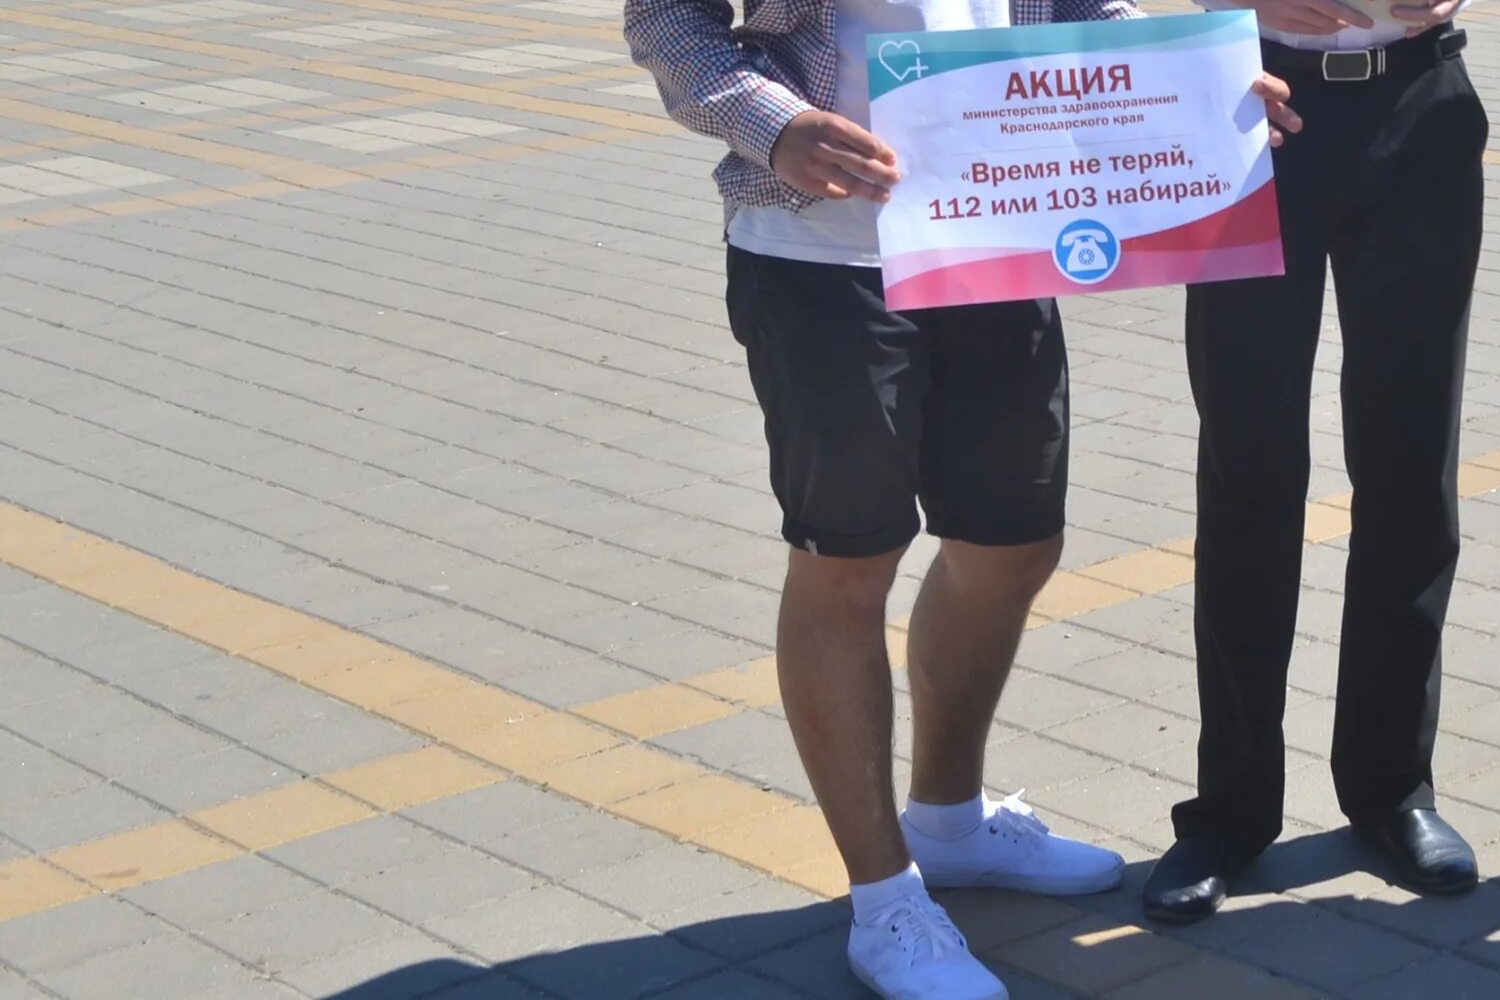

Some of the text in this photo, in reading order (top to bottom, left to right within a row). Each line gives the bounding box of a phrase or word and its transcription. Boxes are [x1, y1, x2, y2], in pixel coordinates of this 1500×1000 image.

[1004, 64, 1132, 100] АКЦИЯ
[963, 93, 1179, 121] министерства здравоохранения
[1000, 113, 1145, 135] Краснодарского края
[961, 145, 1194, 187] «Время не теряй,
[929, 174, 1231, 221] 112 или 103 набирай»
